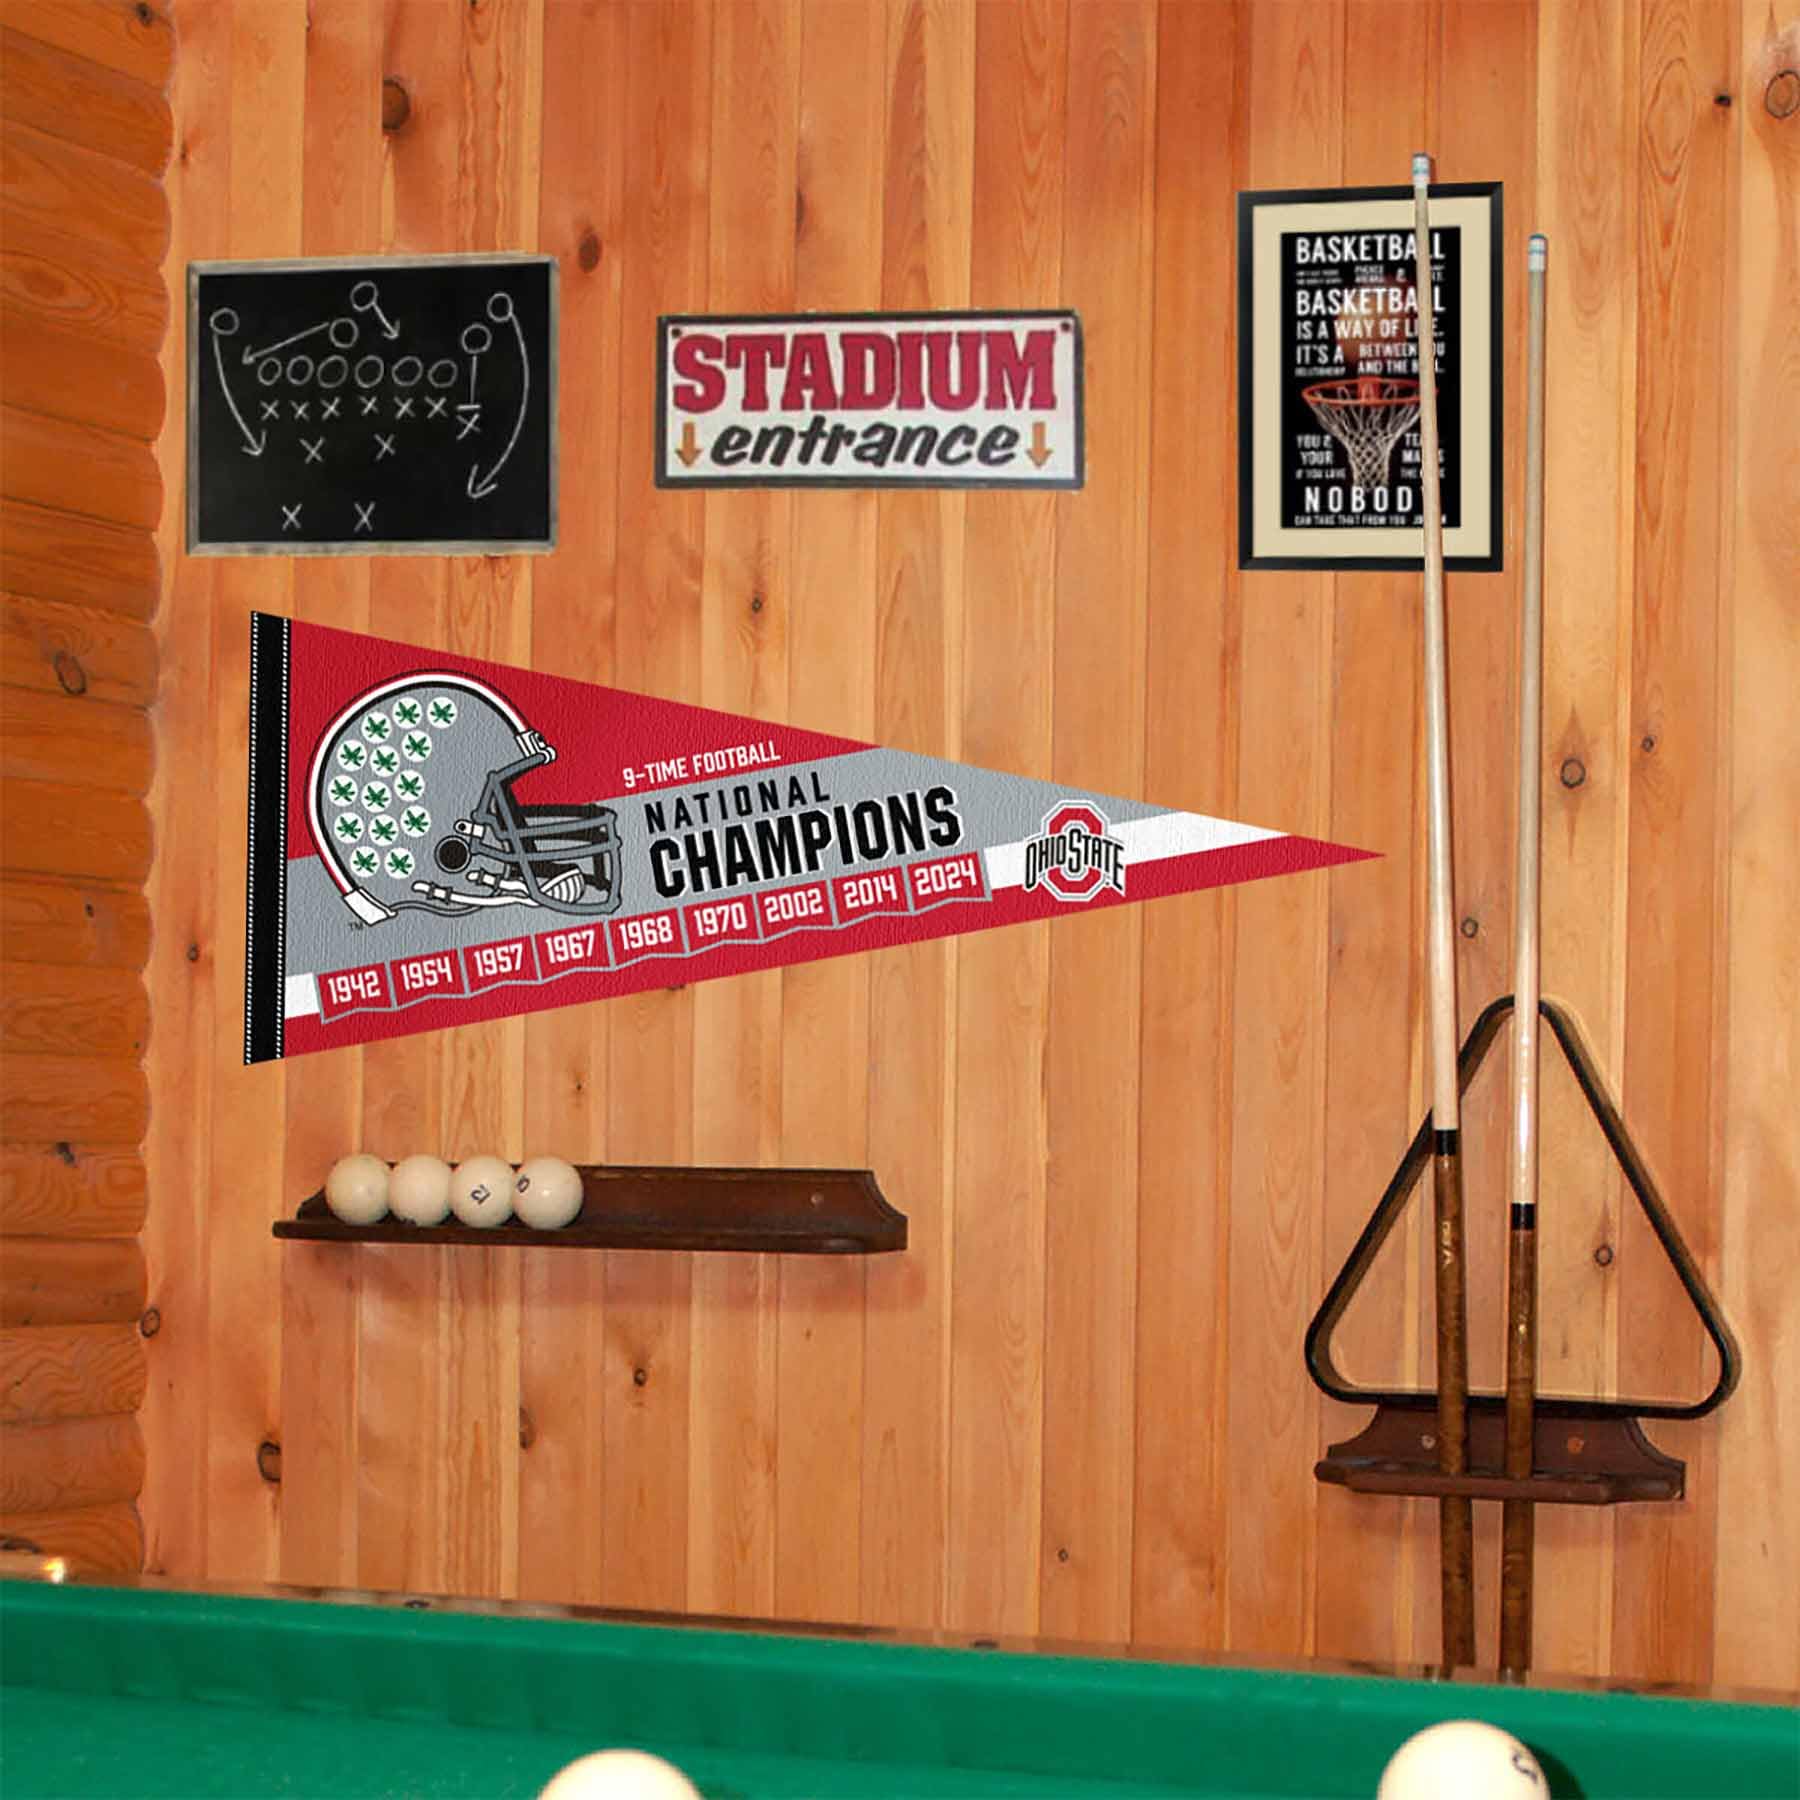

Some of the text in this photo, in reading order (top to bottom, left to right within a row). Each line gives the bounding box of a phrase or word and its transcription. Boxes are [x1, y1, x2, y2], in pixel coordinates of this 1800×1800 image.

[1296, 232, 1446, 264] BASKETBAL
[1296, 286, 1446, 315] BASKETBAL
[1296, 320, 1313, 340] IS
[1317, 320, 1329, 340] A
[1334, 319, 1374, 339] WAY
[1380, 318, 1400, 337] OF
[672, 330, 1057, 414] STADIUM
[1296, 344, 1344, 365] IT'S A
[1358, 360, 1383, 374] AND
[1386, 359, 1408, 374] THE
[710, 415, 1019, 467] entrance
[1300, 451, 1333, 465] YOUR
[1305, 486, 1424, 513] NOBOD
[622, 740, 781, 789] 9-TIME FOOTBALL
[645, 771, 831, 833] NATIONAL
[649, 786, 962, 898] CHAMPIONS
[1025, 828, 1124, 891] OHIO STATE
[327, 860, 978, 1005] 1942 1954 1957 1967 1968 1970 2002 2014 2024
